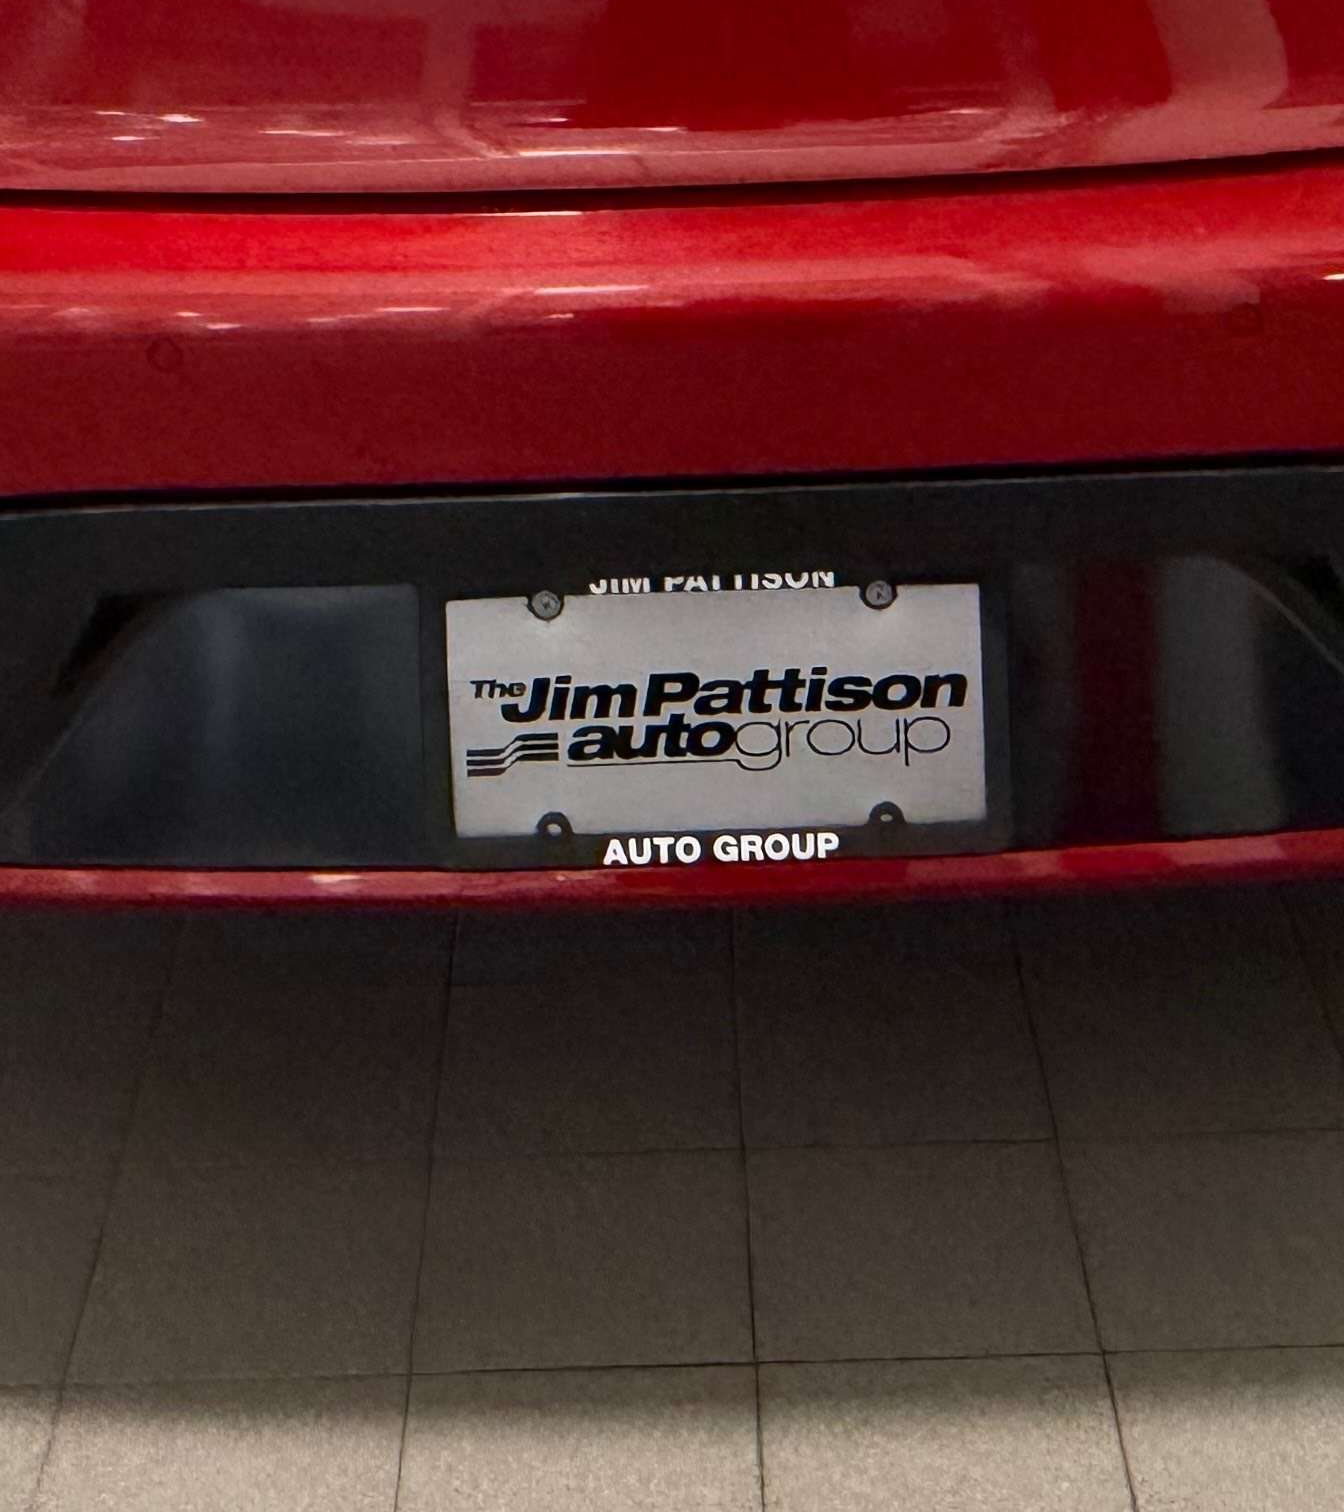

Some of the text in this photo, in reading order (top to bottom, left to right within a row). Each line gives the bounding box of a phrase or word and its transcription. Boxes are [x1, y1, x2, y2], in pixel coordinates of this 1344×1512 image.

[469, 678, 527, 700] The
[602, 831, 840, 865] AUTO GROUP
